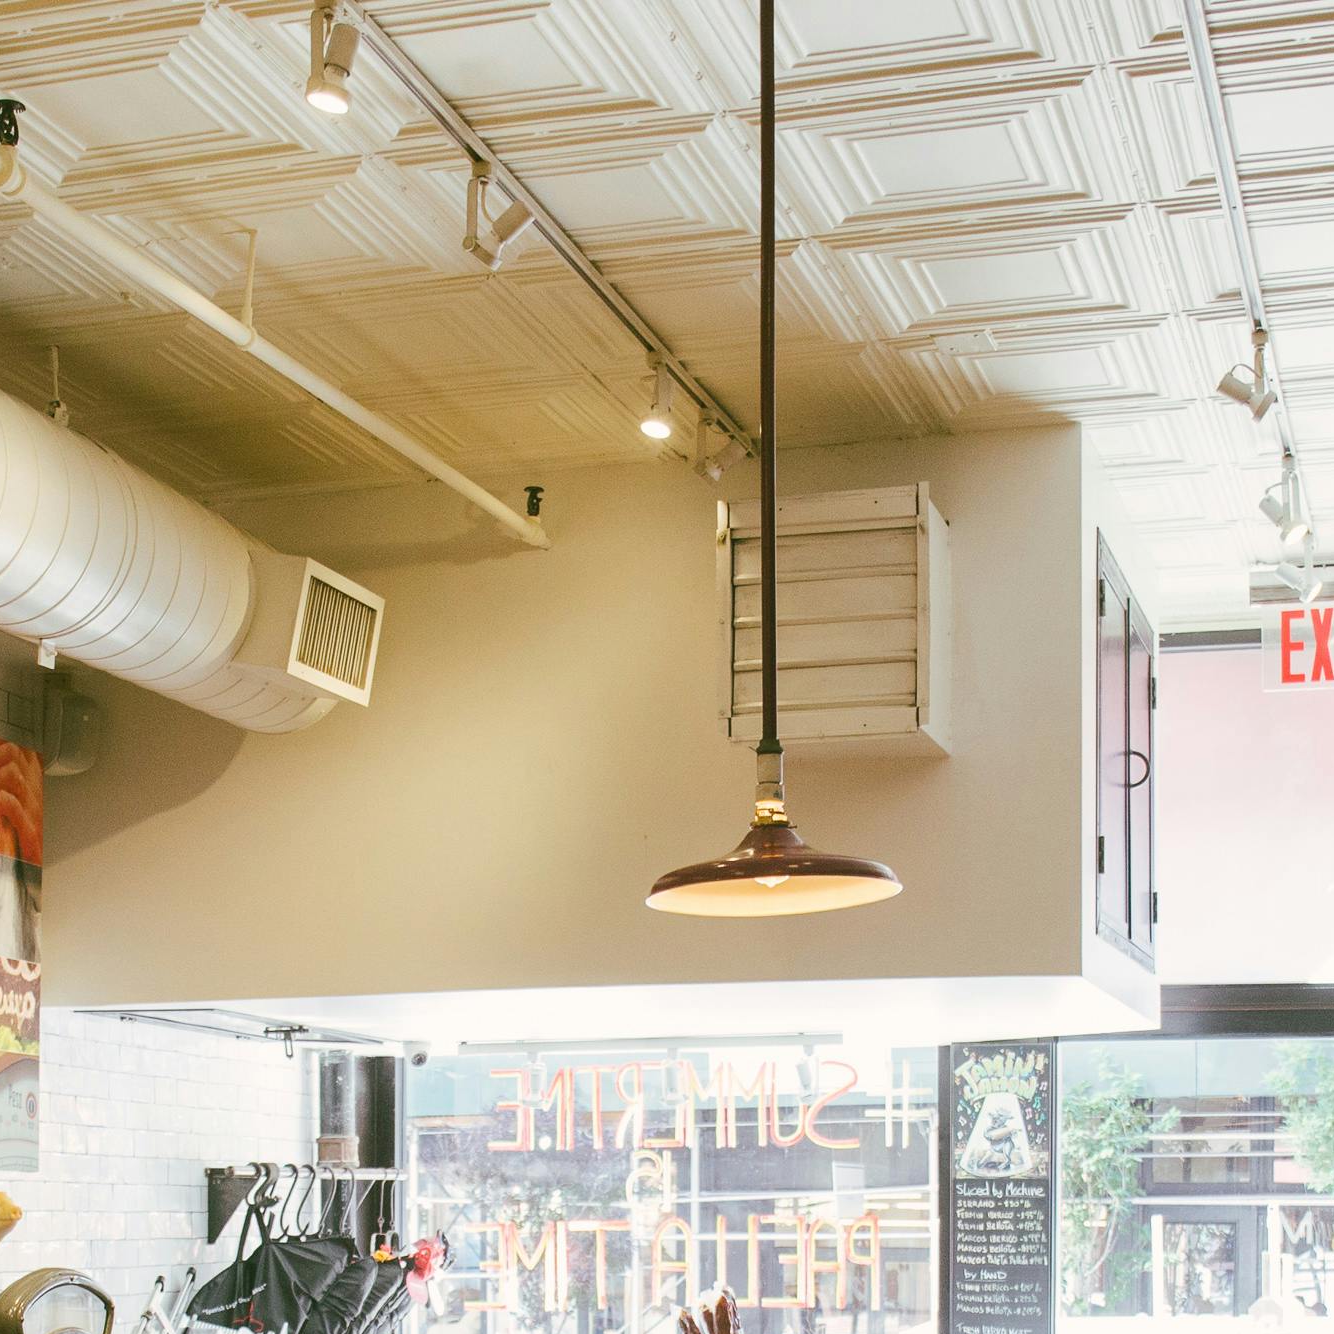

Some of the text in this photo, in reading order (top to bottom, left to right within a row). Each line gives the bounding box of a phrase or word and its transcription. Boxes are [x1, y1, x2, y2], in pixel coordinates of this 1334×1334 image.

[956, 1181, 1046, 1198] Sliced by Machine
[964, 1268, 1007, 1280] by HAND
